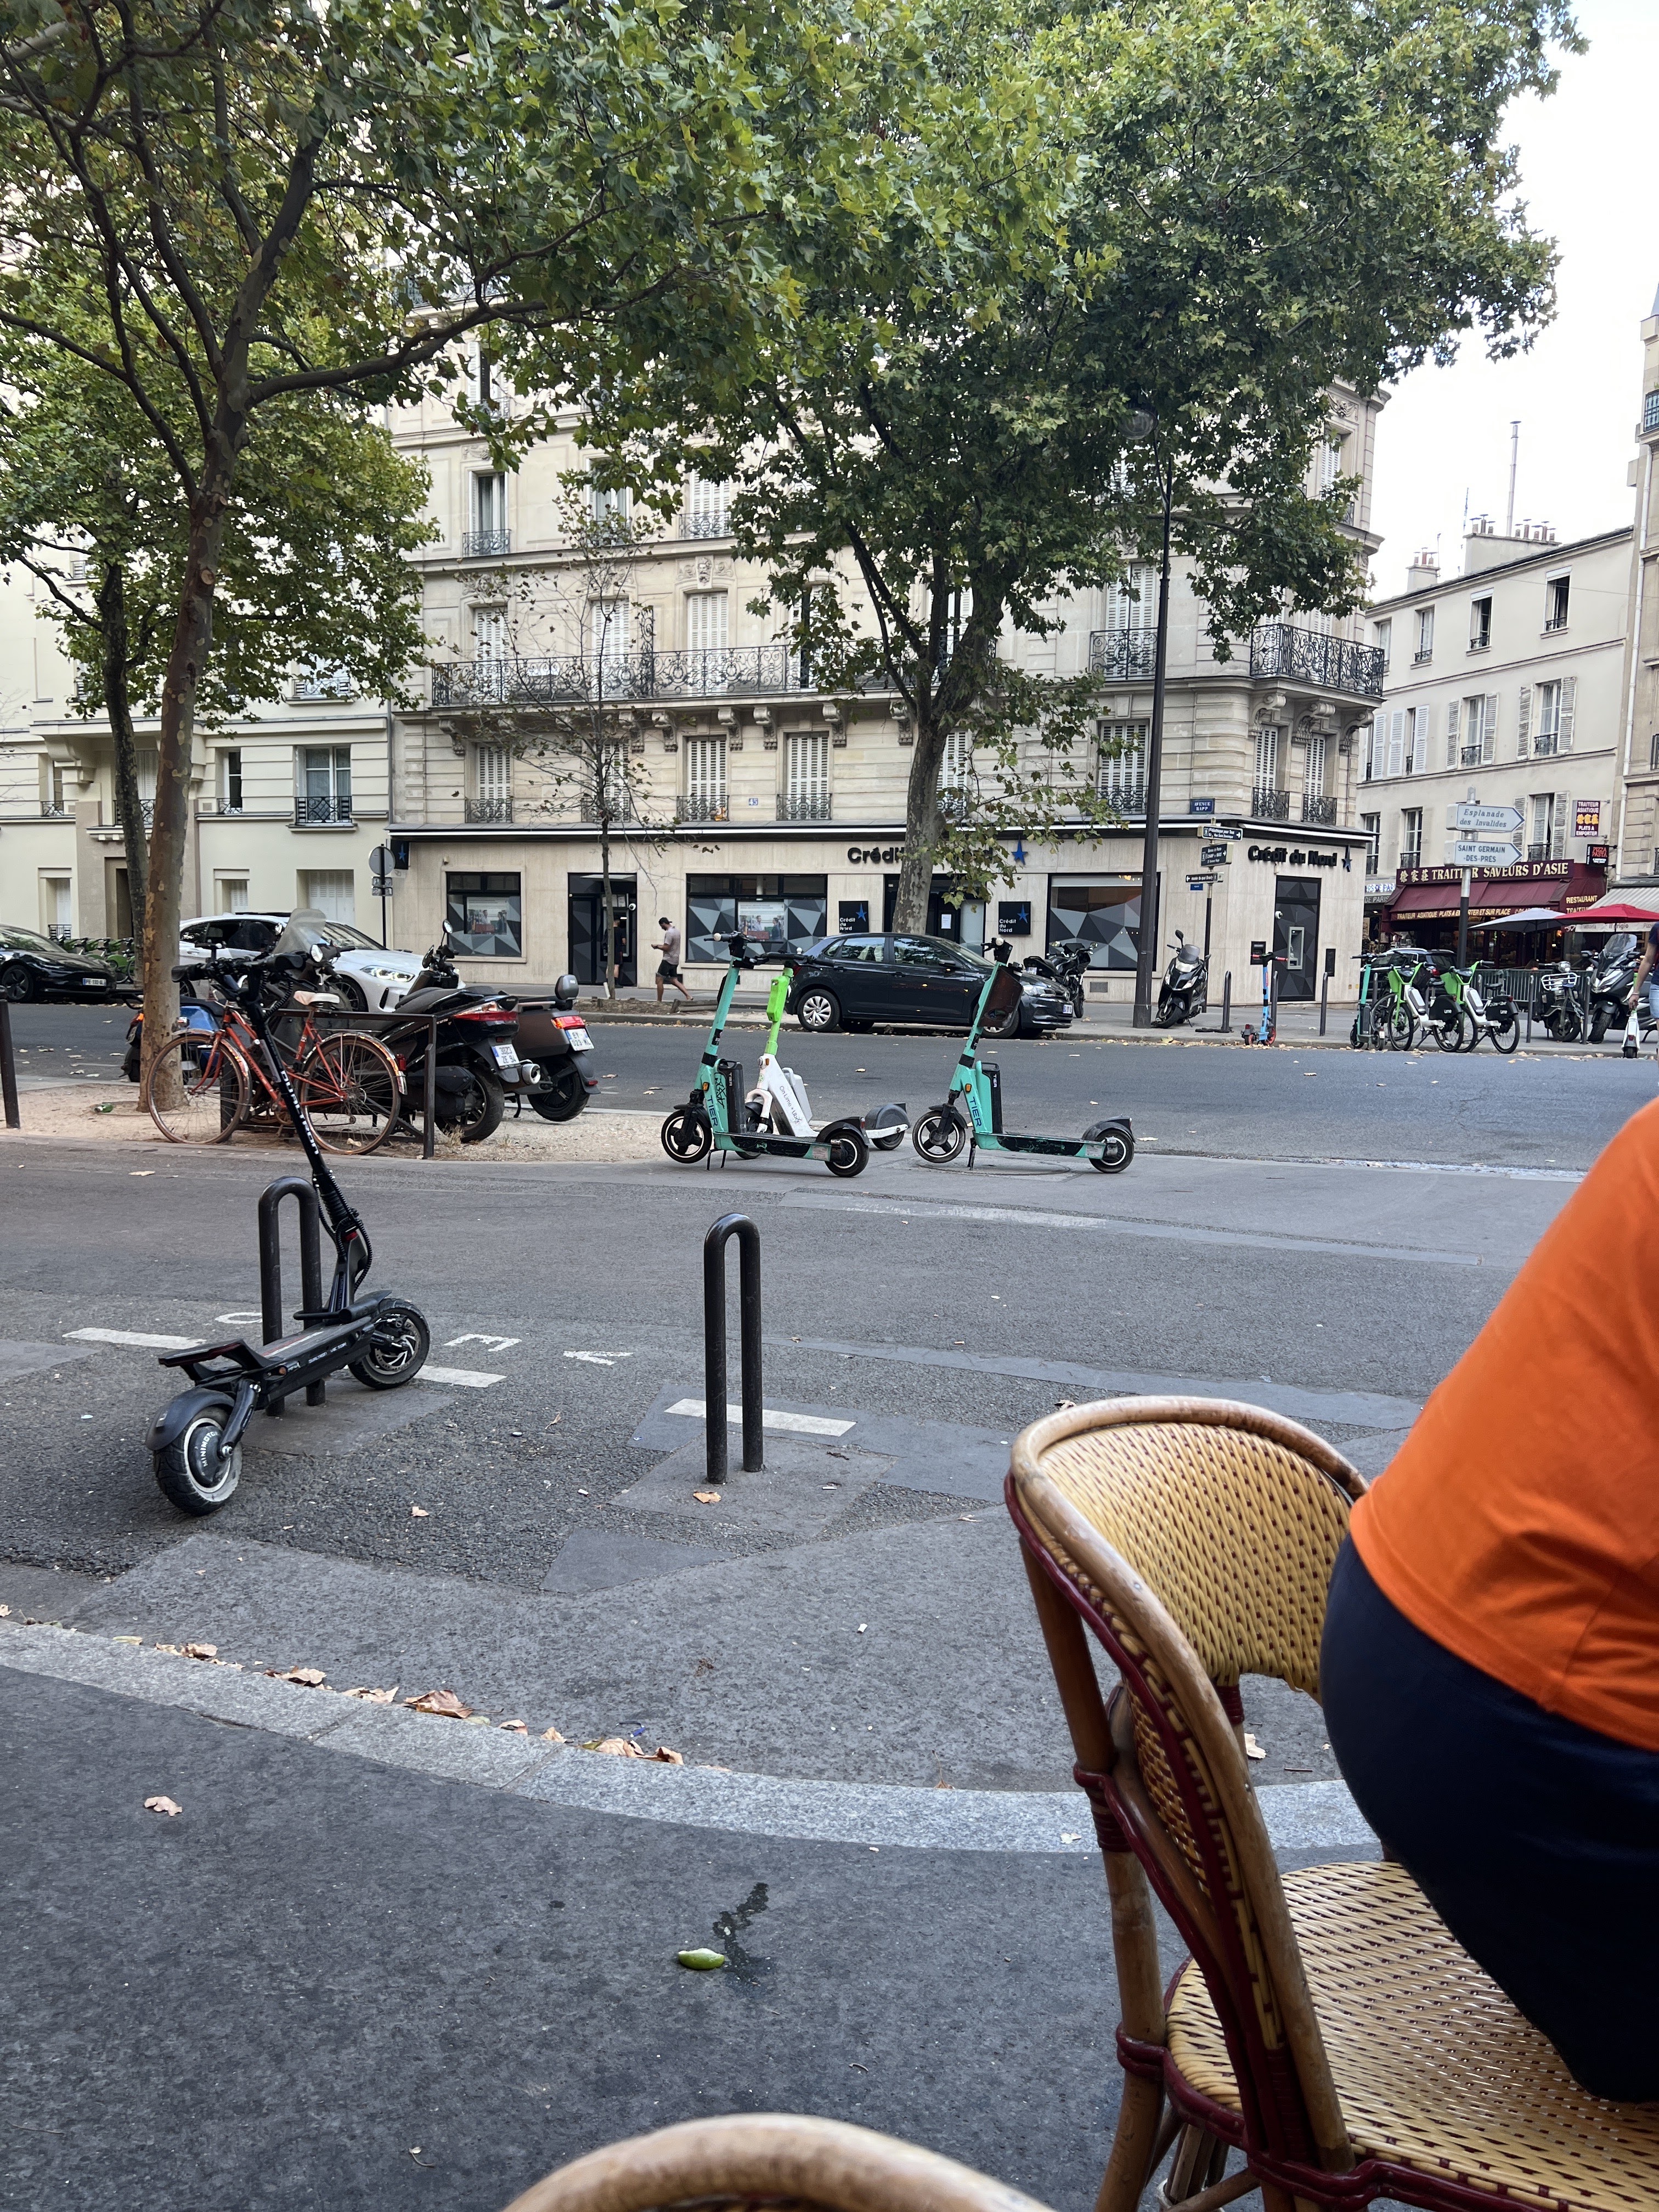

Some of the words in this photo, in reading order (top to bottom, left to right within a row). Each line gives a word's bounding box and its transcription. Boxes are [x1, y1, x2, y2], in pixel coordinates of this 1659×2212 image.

[1464, 809, 1504, 817] Esplanade
[1476, 819, 1507, 827] Invalides
[1248, 845, 1288, 862] Crédit
[1289, 849, 1306, 864] du
[1308, 850, 1338, 866] Nord
[1432, 867, 1479, 880] TRAITR
[1483, 865, 1529, 878] SAVEURS
[1533, 862, 1568, 876] D'ASIE
[1566, 895, 1598, 904] RESTAURANT
[780, 1086, 786, 1094] On
[783, 1093, 792, 1107] Lime
[707, 1094, 718, 1126] TIER
[969, 1096, 982, 1127] TIER
